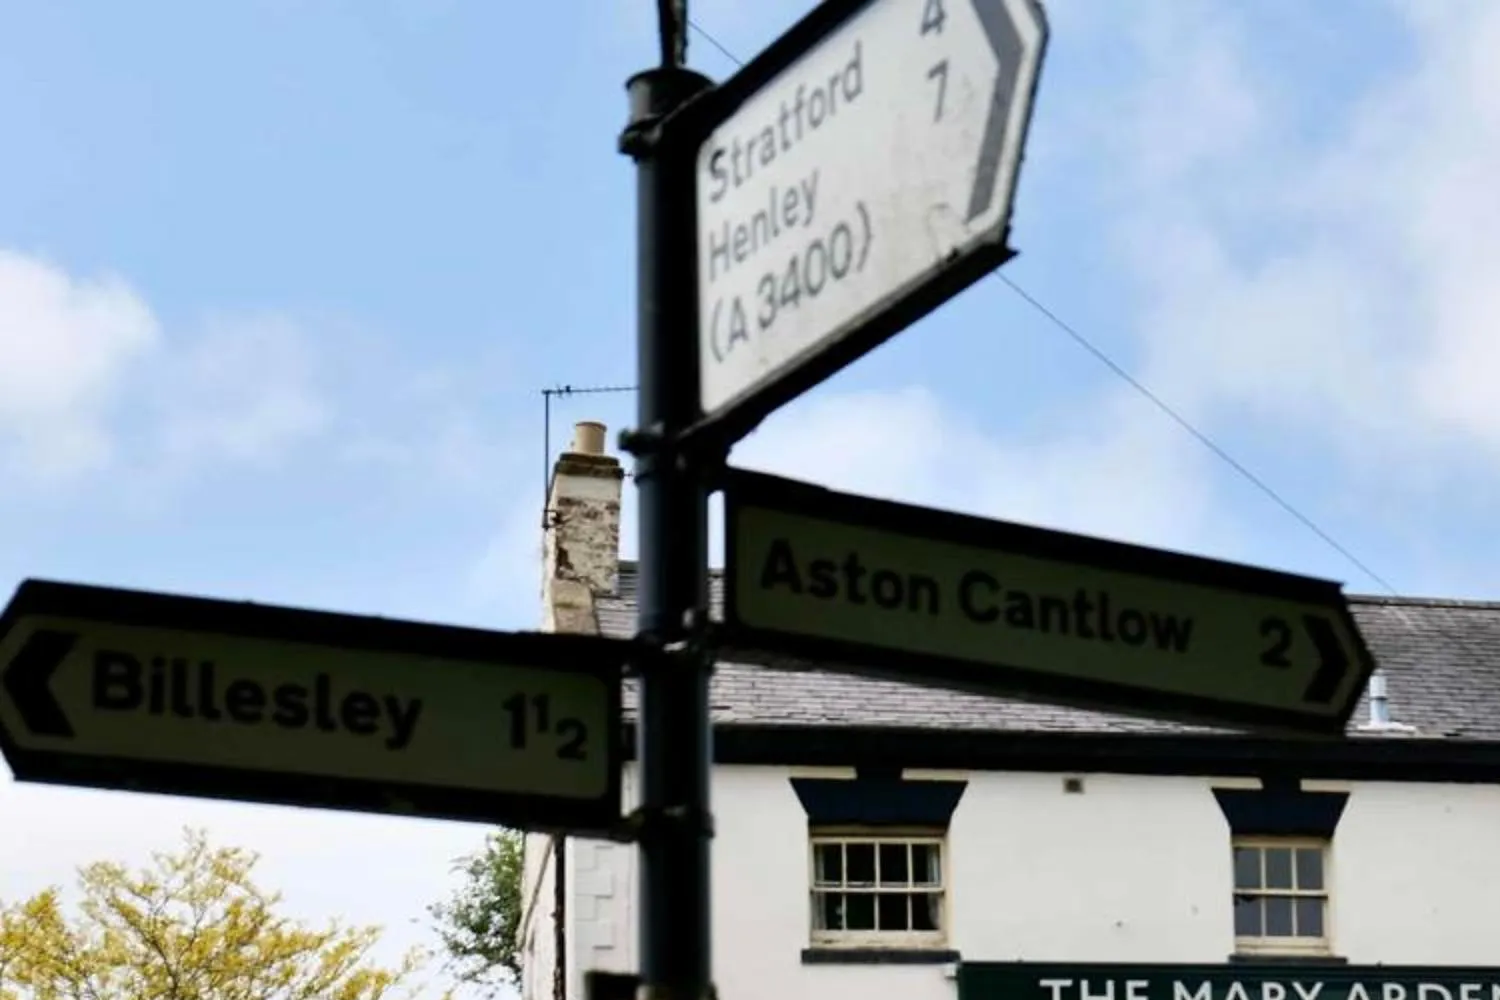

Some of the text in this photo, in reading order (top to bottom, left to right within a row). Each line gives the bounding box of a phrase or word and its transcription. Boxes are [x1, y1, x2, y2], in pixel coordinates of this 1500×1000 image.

[707, 40, 864, 203] Stratford
[709, 58, 948, 282] Henley 7
[760, 538, 1292, 669] Aston Cantlow 2
[93, 650, 422, 749] Billesley
